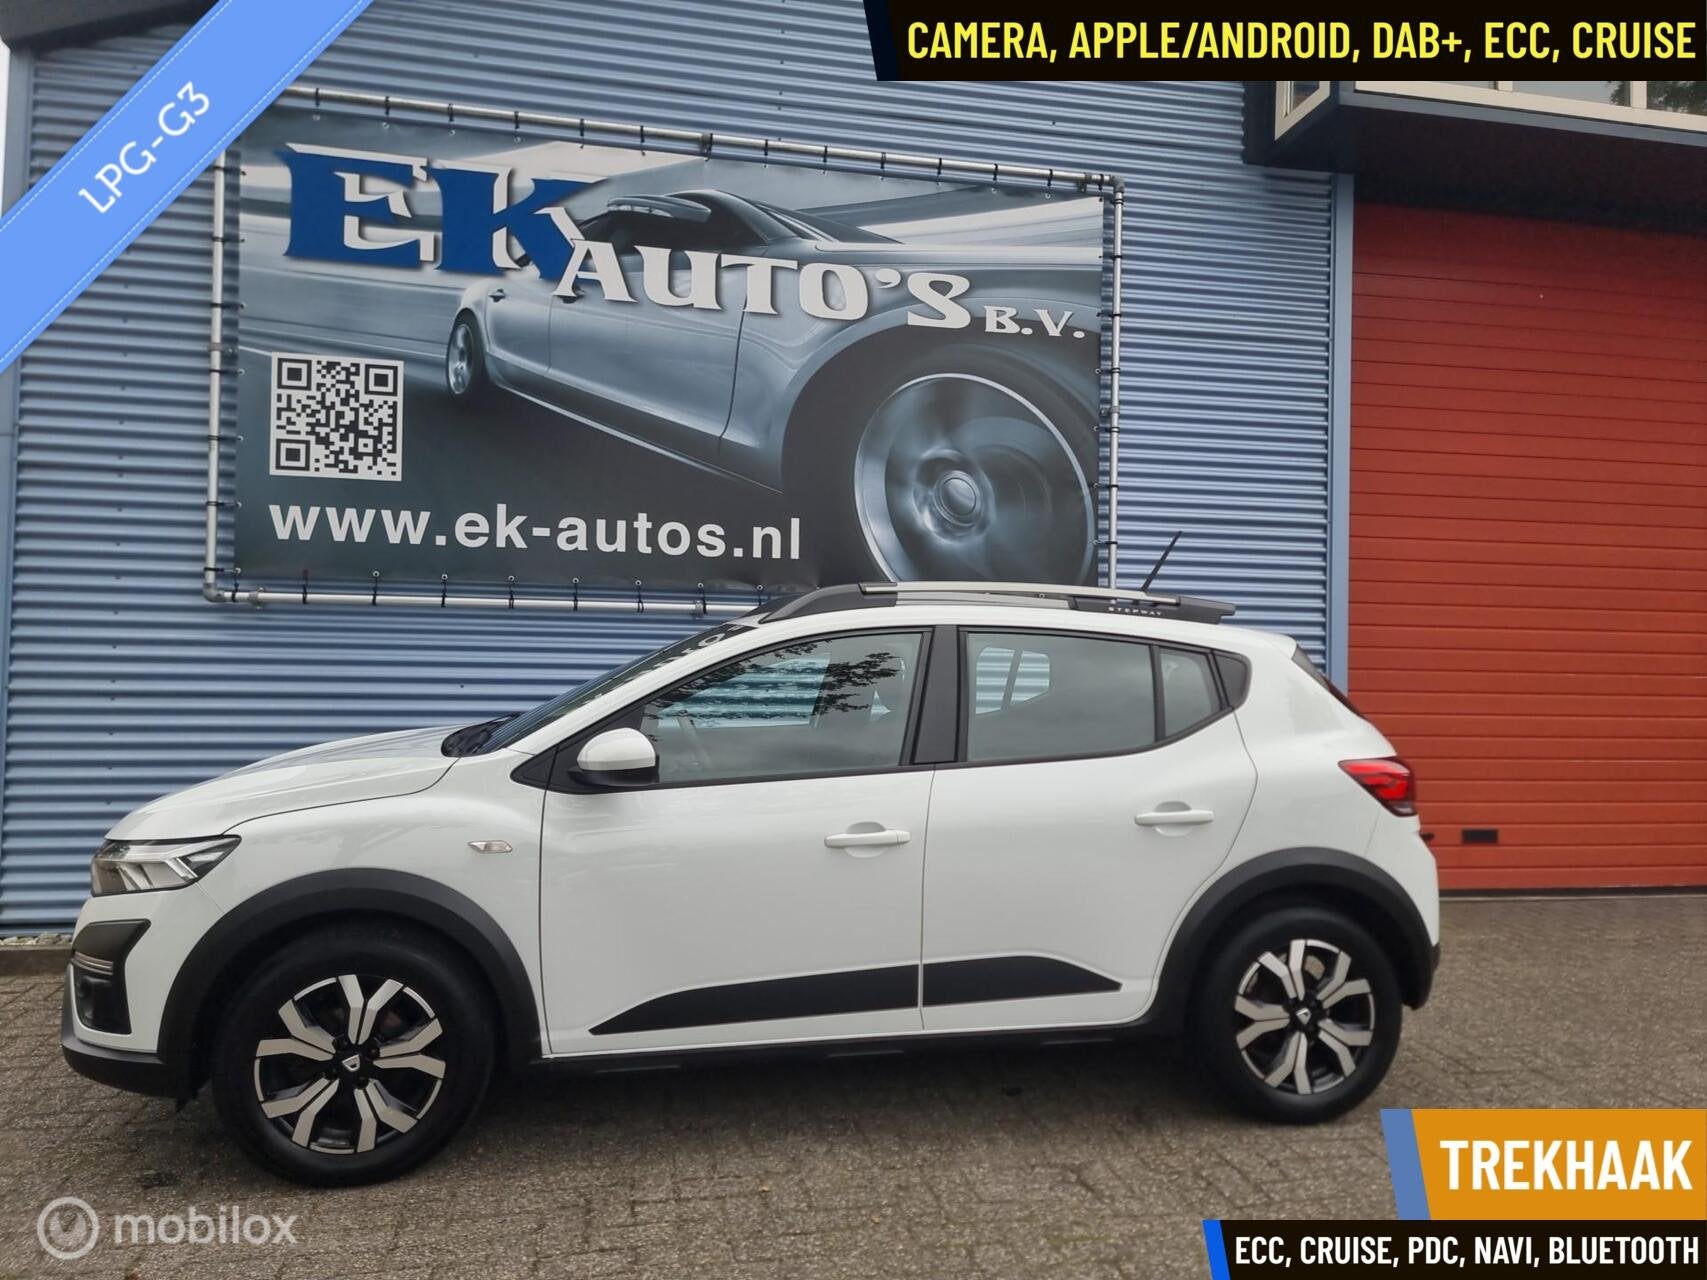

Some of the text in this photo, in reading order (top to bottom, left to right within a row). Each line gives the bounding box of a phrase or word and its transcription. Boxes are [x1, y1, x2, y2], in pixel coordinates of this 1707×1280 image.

[279, 143, 608, 281] EK
[983, 304, 1086, 339] B.V.
[268, 503, 801, 560] www.ek-autos.nl
[1107, 606, 1163, 616] STEPWAY
